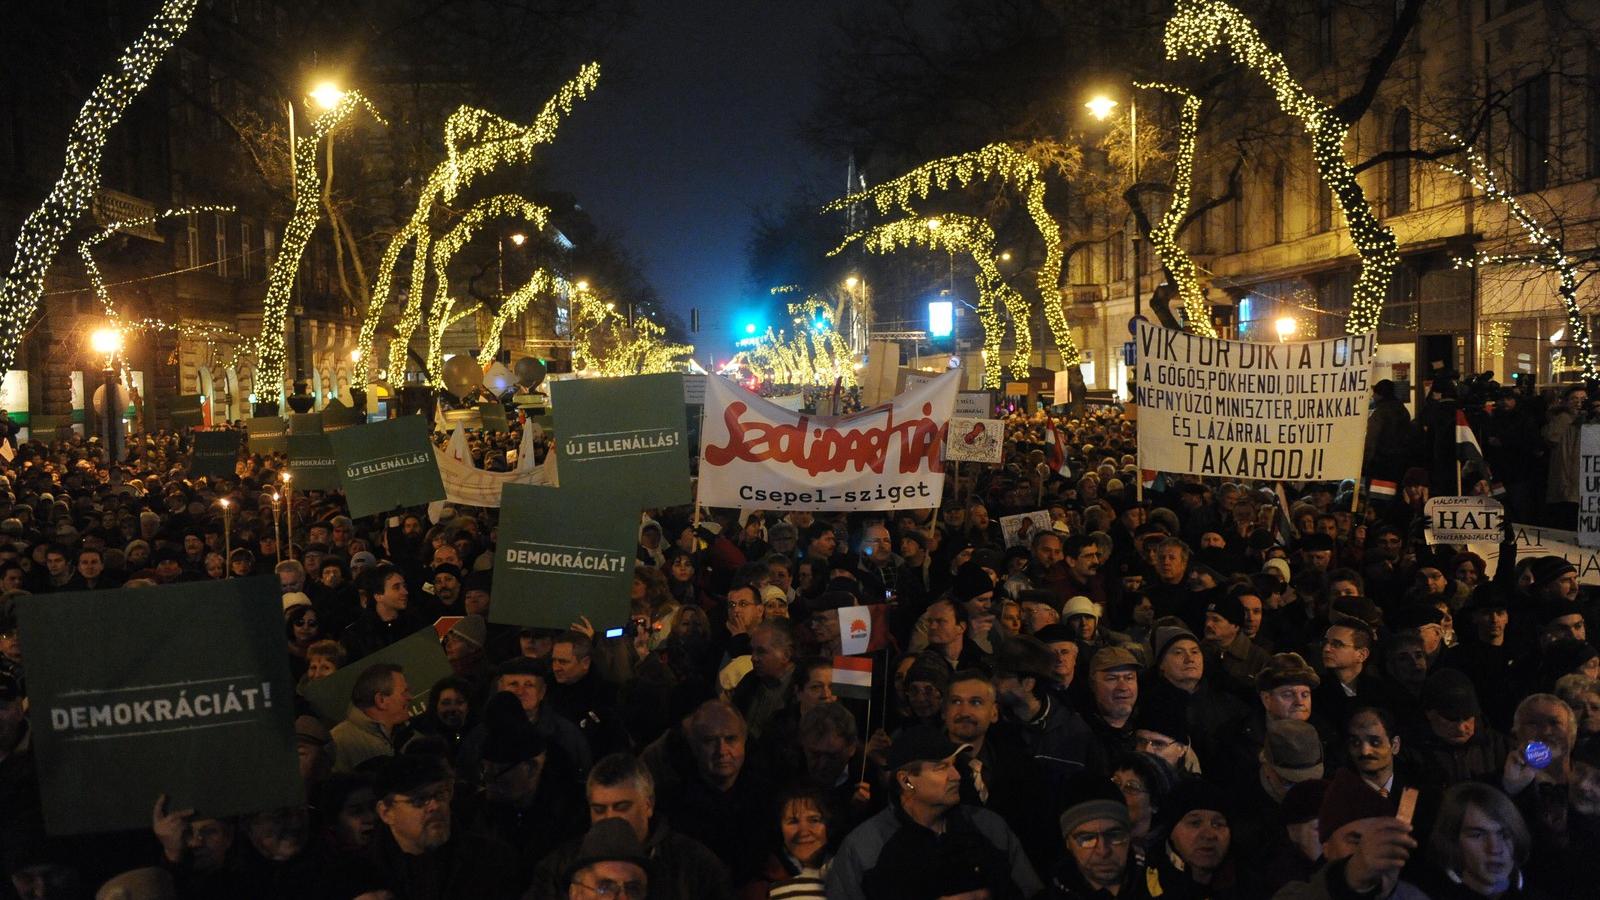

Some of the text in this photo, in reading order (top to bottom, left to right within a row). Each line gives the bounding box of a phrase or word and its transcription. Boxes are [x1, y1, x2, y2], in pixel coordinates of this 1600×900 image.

[1141, 324, 1230, 367] VIKTOR
[1144, 362, 1151, 382] A
[1137, 385, 1212, 415] NÉPNYÚZÓ
[1172, 413, 1334, 444] ÉS LÁZÁRRAL EGYÜTT
[565, 431, 679, 455] ÚJ ELLENÁLLÁS!
[346, 453, 430, 477] ÚJ ELLENÁLLÁS!
[1184, 442, 1324, 480] TAKARODJ!
[739, 481, 930, 505] Csepel-sziget
[1437, 511, 1498, 530] HAT
[506, 549, 627, 572] DEMOKRÁCIÁT!
[50, 681, 273, 731] DEMOKRÁCIÁT!
